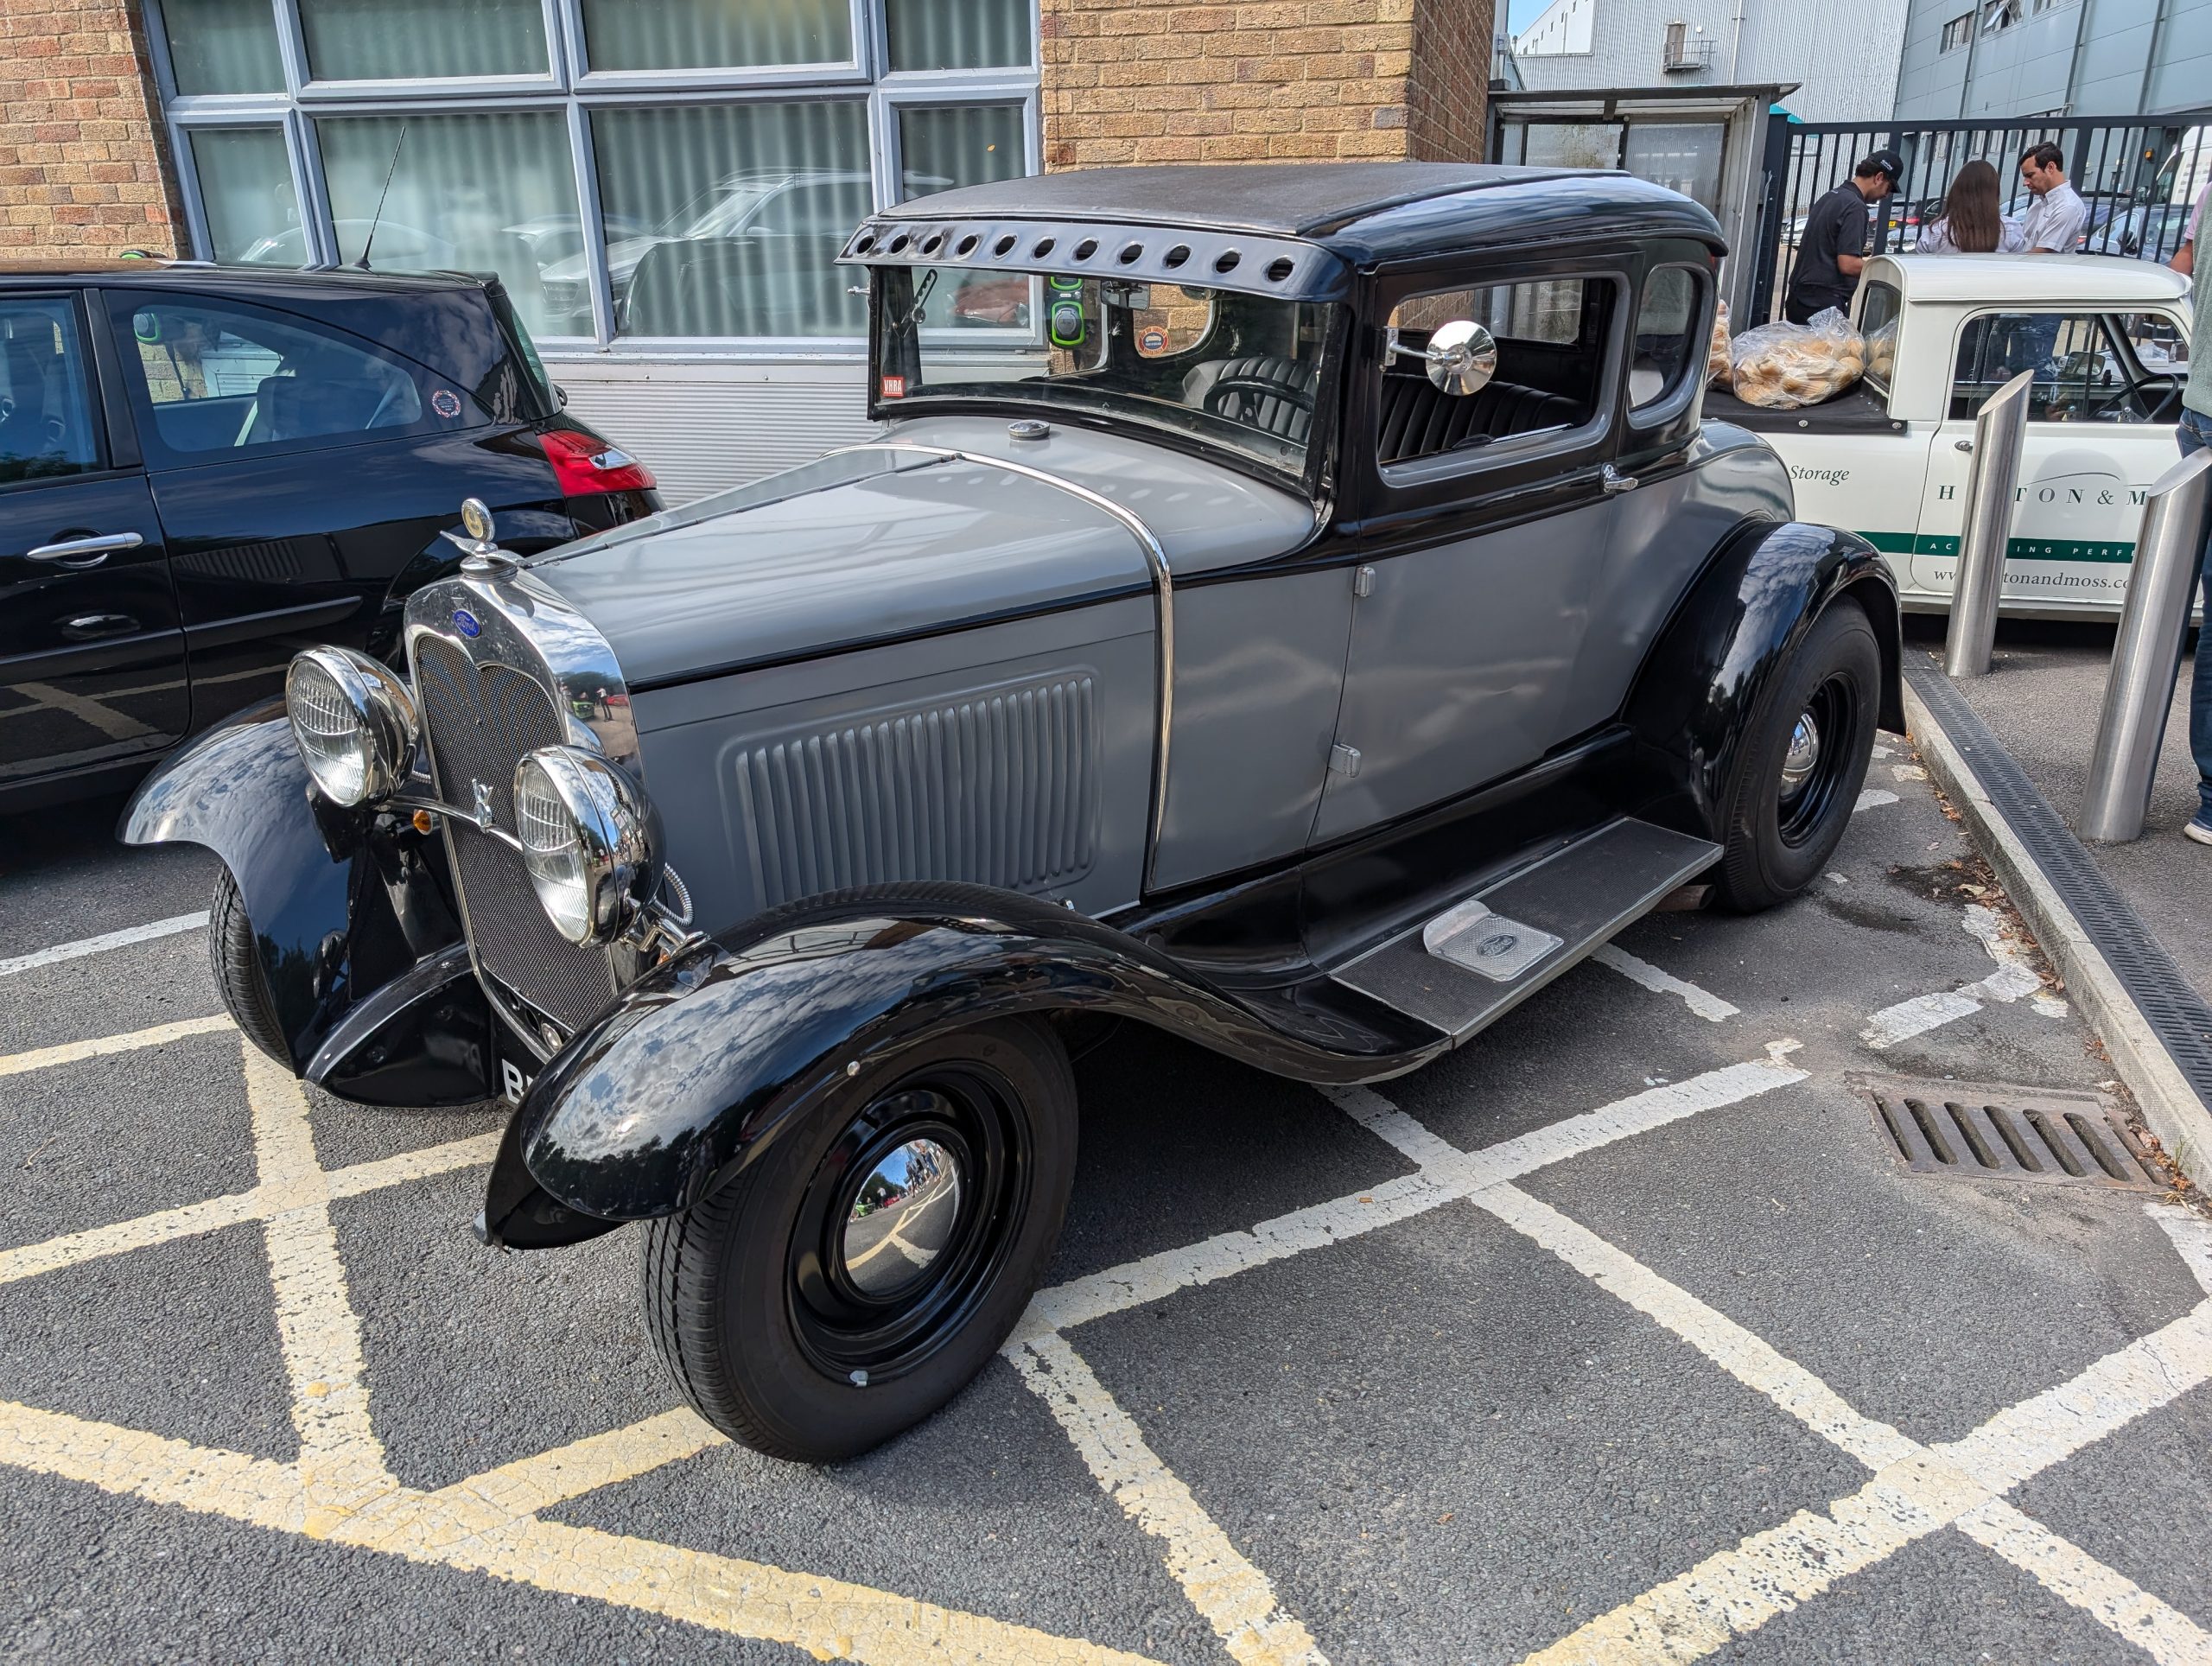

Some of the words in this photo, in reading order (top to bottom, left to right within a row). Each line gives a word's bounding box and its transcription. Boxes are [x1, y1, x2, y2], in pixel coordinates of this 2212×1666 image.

[884, 379, 902, 392] VHRA
[1790, 465, 1850, 486] Storage
[1936, 485, 2085, 504] HTON
[2097, 489, 2114, 506] &
[1929, 543, 2052, 554] ACING
